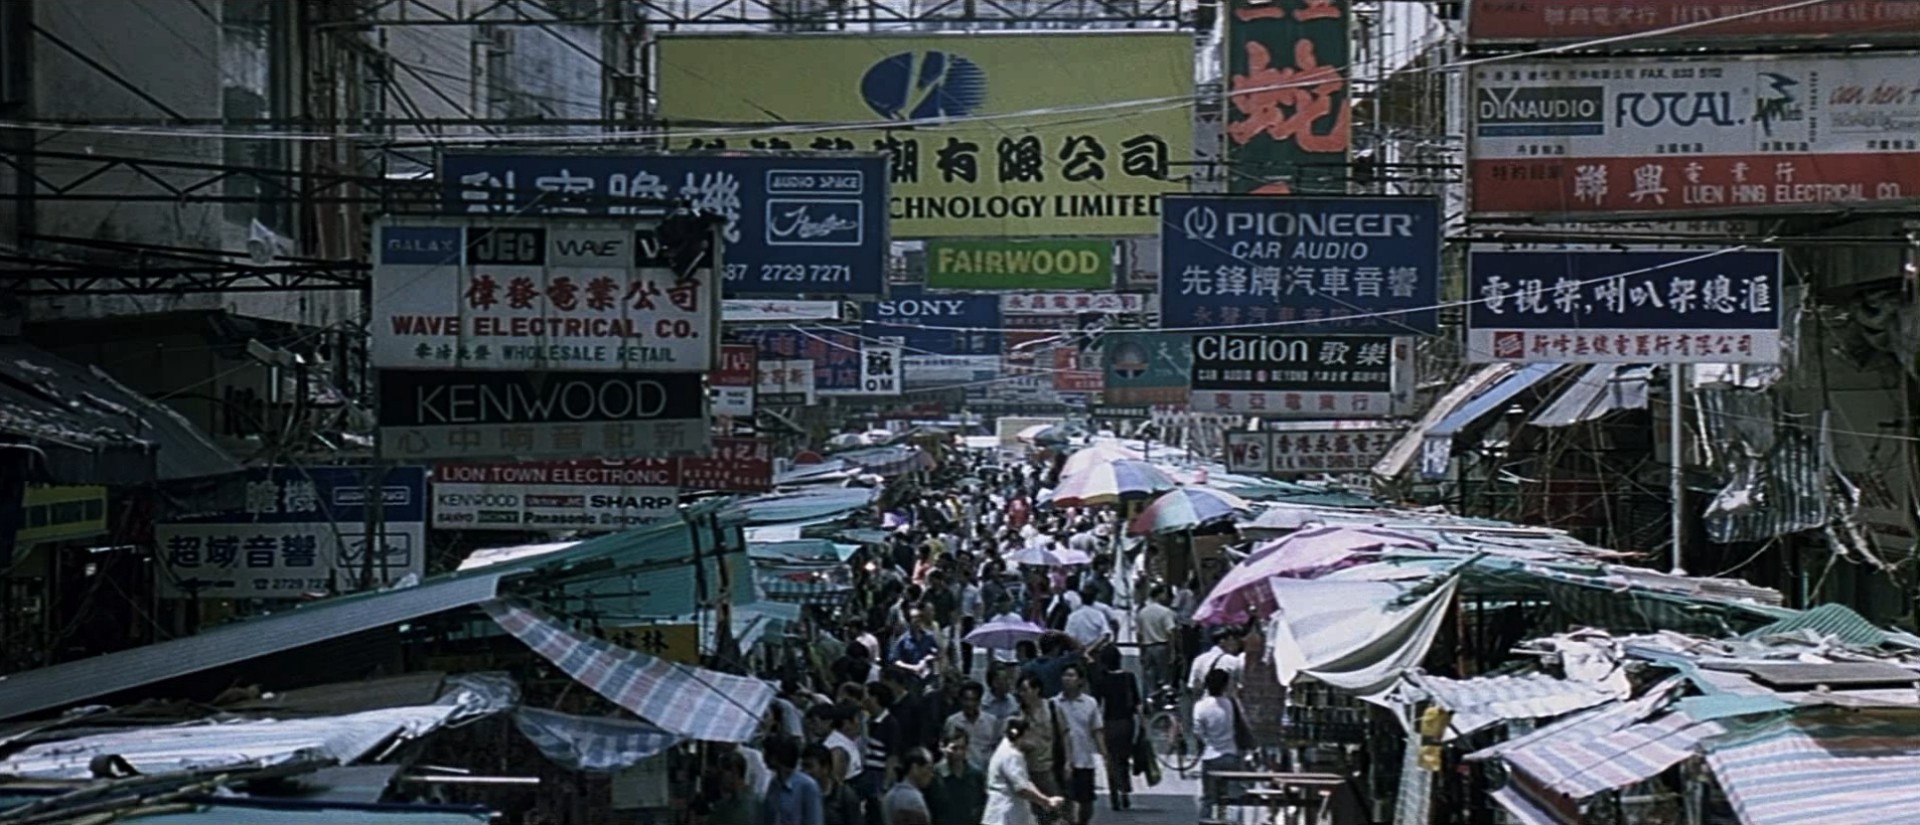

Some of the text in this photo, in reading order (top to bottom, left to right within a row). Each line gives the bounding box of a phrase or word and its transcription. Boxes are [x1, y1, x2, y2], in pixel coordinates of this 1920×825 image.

[1228, 38, 1348, 152] 蛇
[1479, 88, 1595, 120] DYNAUDIO
[772, 176, 860, 189] AUDIO SPACE
[1683, 184, 1724, 204] LUEN
[1731, 184, 1767, 204] HING
[1774, 182, 1864, 203] ELECTRICAL
[1225, 211, 1414, 237] PIONEER
[936, 247, 1100, 275] FAIRWOOD
[1231, 241, 1369, 261] CAR AUDIO
[760, 264, 805, 282] 2729
[809, 264, 851, 282] 7271
[1181, 264, 1419, 298] 先鋒牌汽車音響
[878, 299, 964, 317] SONY
[391, 315, 699, 339] WAVE ELECTRICAL CO.
[502, 345, 677, 363] WHOLESALE RETAIL
[1197, 335, 1310, 362] Clarion
[1317, 340, 1390, 366] 歌樂
[415, 378, 668, 424] KENWOOD
[442, 467, 670, 485] LION TOWN ELECTRONIC
[590, 495, 672, 510] SHARP
[523, 511, 597, 525] Panasonic
[167, 534, 317, 568] 超域音響
